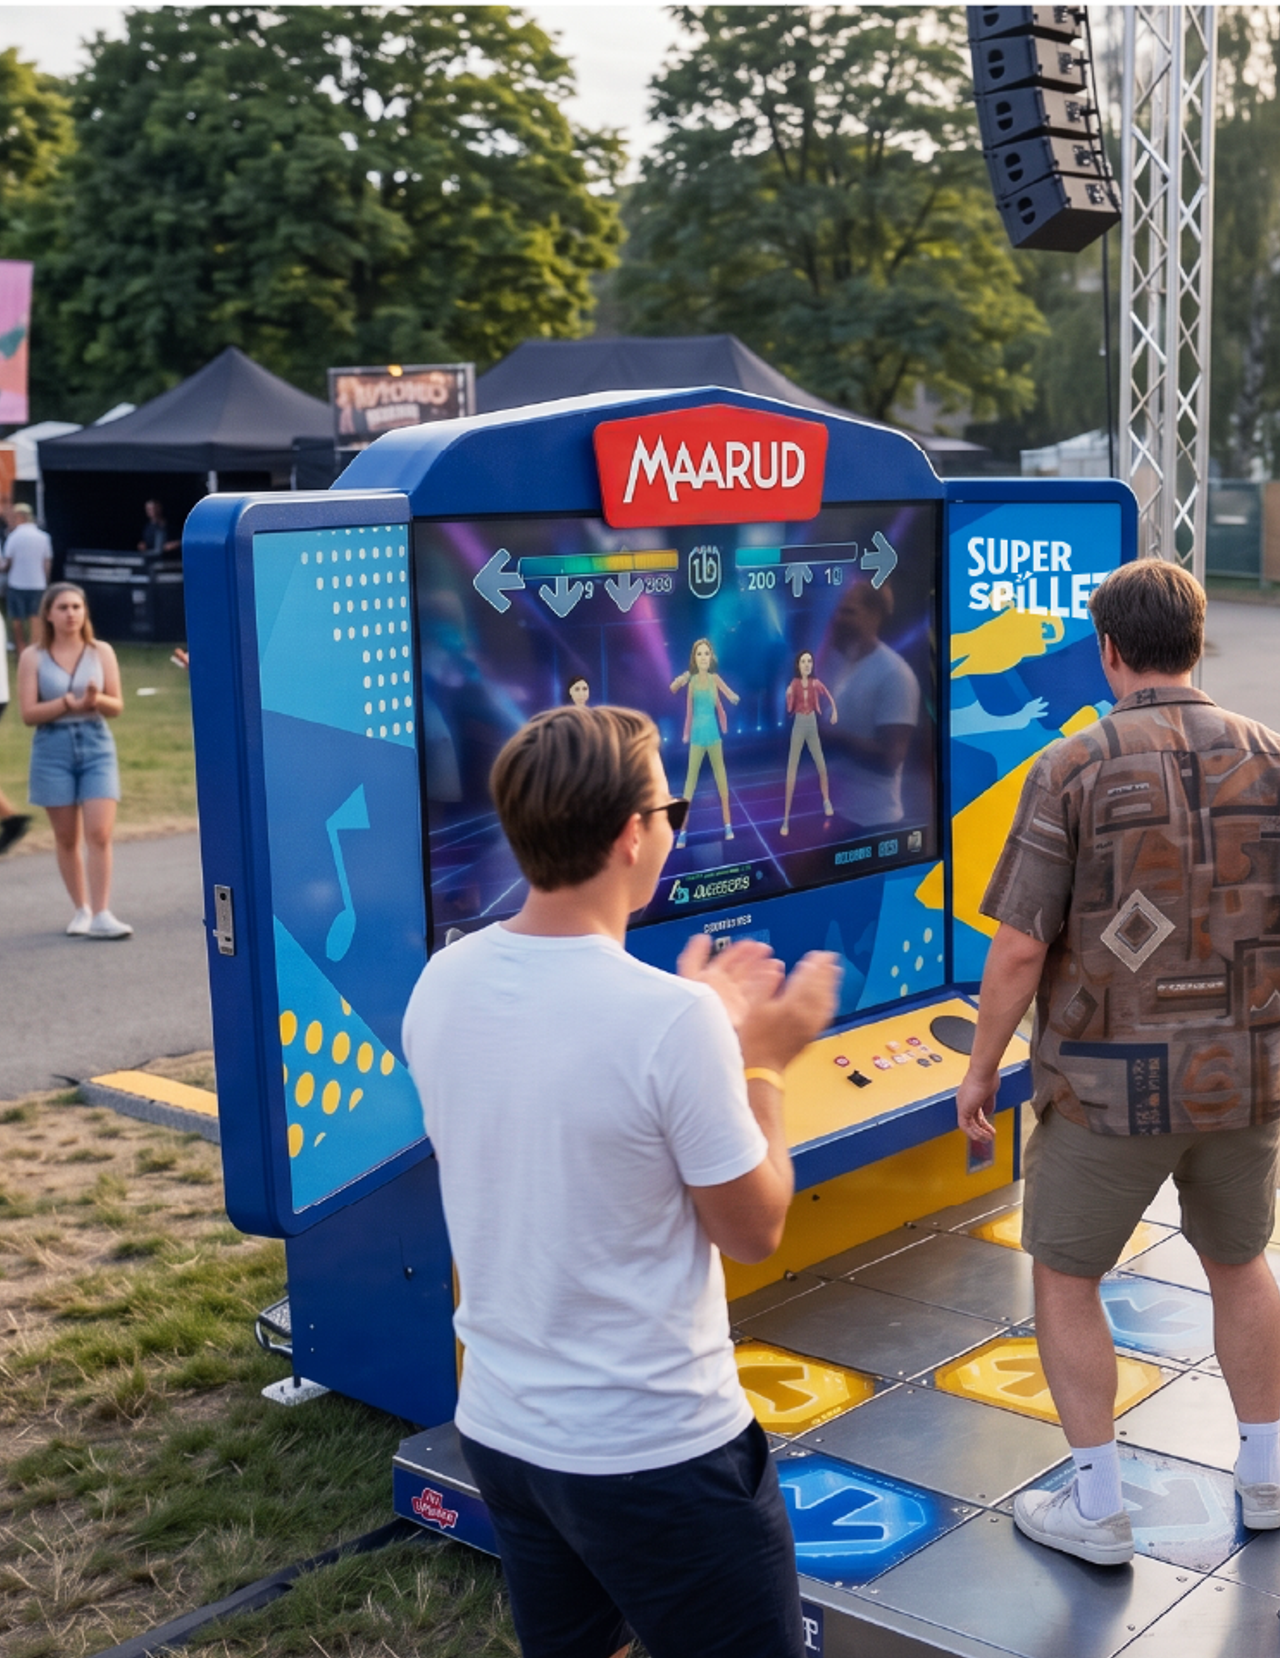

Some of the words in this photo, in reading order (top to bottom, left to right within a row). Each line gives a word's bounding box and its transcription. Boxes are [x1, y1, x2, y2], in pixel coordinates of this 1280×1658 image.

[622, 434, 806, 503] MAARUD
[967, 536, 1072, 577] SUPER
[748, 570, 776, 591] 200
